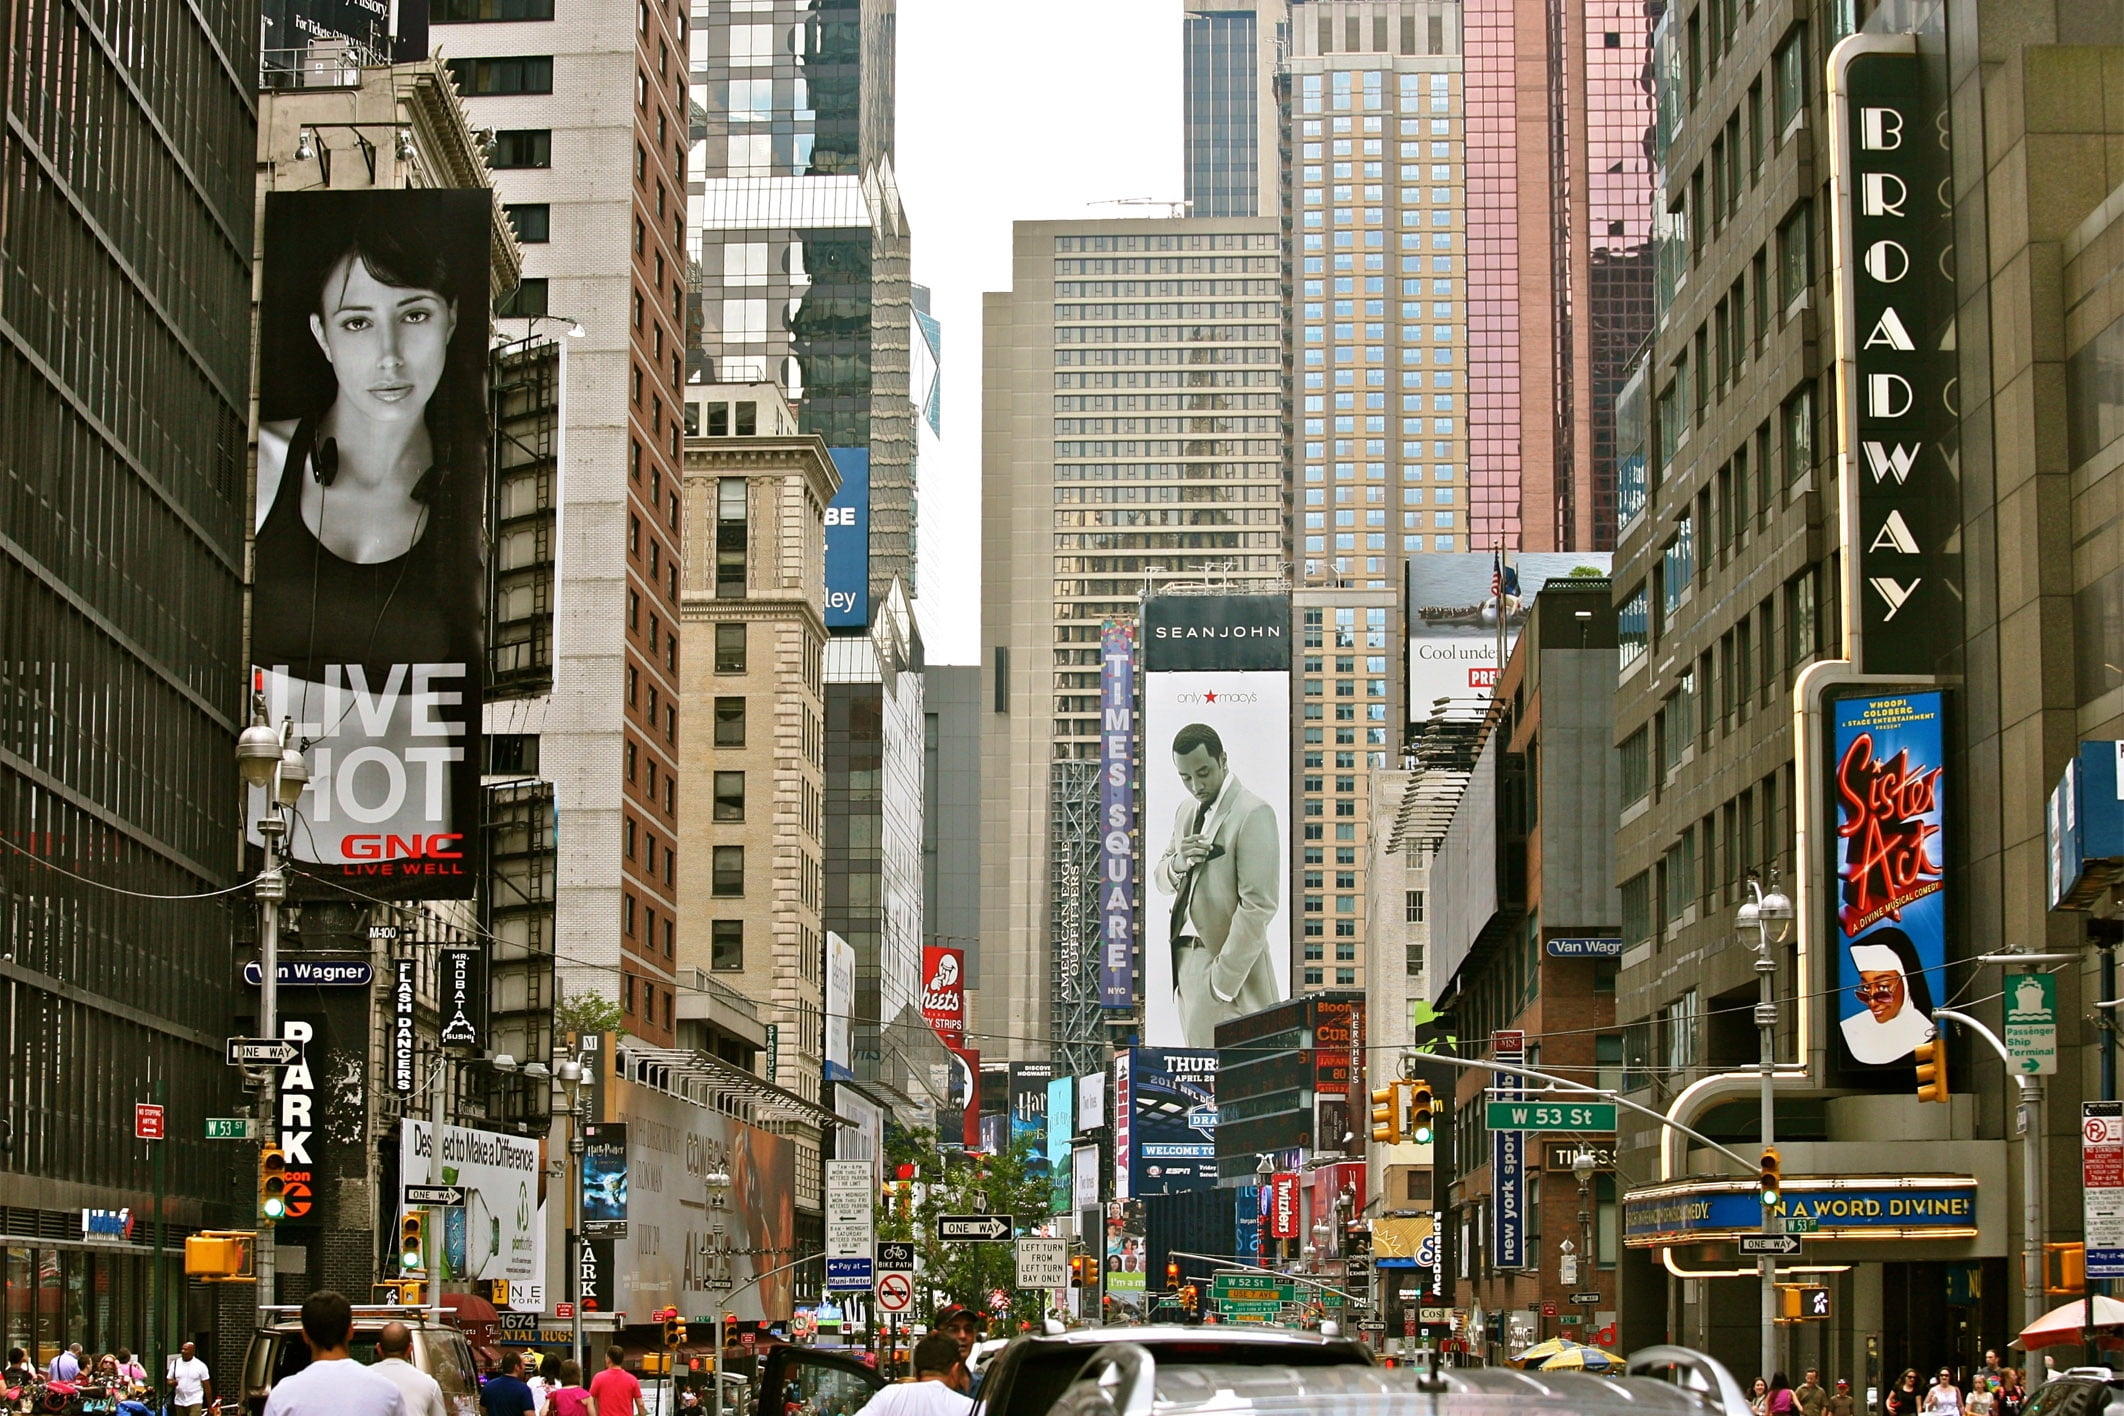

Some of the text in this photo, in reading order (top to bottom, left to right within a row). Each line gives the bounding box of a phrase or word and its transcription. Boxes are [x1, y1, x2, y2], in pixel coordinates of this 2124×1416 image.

[296, 14, 307, 30] For
[1861, 107, 1921, 622] BROADWAY
[1419, 643, 1497, 660] Cool unde
[1471, 672, 1497, 685] PRE
[271, 663, 466, 738] LIVE
[1177, 690, 1257, 704] only macy's
[1869, 699, 1907, 709] WHOOPI
[1848, 712, 1935, 727] STAGE ENTERTAINMENT
[1863, 706, 1913, 718] GOLDBERG
[1105, 653, 1130, 788] TIMES
[1838, 733, 1943, 838] Sister
[340, 833, 463, 859] GNC
[1849, 812, 1943, 910] Act
[343, 862, 463, 876] LIVE WELL
[1104, 803, 1131, 968] SQUARE
[1853, 881, 1939, 933] A DIVINE MUSICAL COMEDY
[1061, 841, 1070, 1003] AMERICAN EAGLE
[1071, 865, 1080, 977] OUTFITTERS
[369, 927, 396, 939] M-100
[1553, 941, 1622, 955] Van Wag
[294, 964, 365, 981] Wagner
[397, 962, 412, 1013] FLASH
[454, 960, 466, 1019] ROBATA
[1107, 987, 1126, 995] NYC
[921, 984, 959, 1011] heets
[935, 1018, 962, 1030] STRIPS
[2007, 1028, 2054, 1036] Passenger
[2007, 1038, 2031, 1046] Ship
[269, 1047, 291, 1057] WAY
[396, 1018, 412, 1090] DANCERS
[767, 1026, 775, 1083] STARBUCK
[2008, 1048, 2054, 1056] Terminal
[1163, 1056, 1218, 1073] THUR
[281, 1021, 314, 1164] PARK
[1150, 1075, 1199, 1101] 2011 NFL
[1193, 1115, 1218, 1125] DRA
[1512, 1108, 1592, 1125] W 53 St
[208, 1121, 243, 1136] W 53 ST
[415, 1124, 534, 1173] Desed to Make a Difference
[1146, 1146, 1215, 1155] WELCOME TO
[285, 1171, 311, 1181] con
[413, 1191, 457, 1199] ONE WAY
[1504, 1131, 1518, 1260] new york spor
[1278, 1178, 1293, 1233] Twizzlers
[1774, 1198, 1969, 1217] N A WORD, DIVINE!
[948, 1224, 1001, 1233] ONE WAY
[1788, 1220, 1795, 1231] W
[1797, 1220, 1807, 1231] 53
[1021, 1243, 1063, 1251] LEFT TURN
[1748, 1240, 1791, 1248] ONE WAY
[1433, 1211, 1442, 1296] McDonald's
[838, 1263, 850, 1271] Pay
[1021, 1264, 1063, 1272] LEFT TURN
[829, 1277, 870, 1285] Muni-Meter
[1022, 1274, 1061, 1282] BAY ONLY
[1228, 1278, 1236, 1286] W
[1254, 1279, 1264, 1287] St
[500, 1314, 535, 1329] 1674
